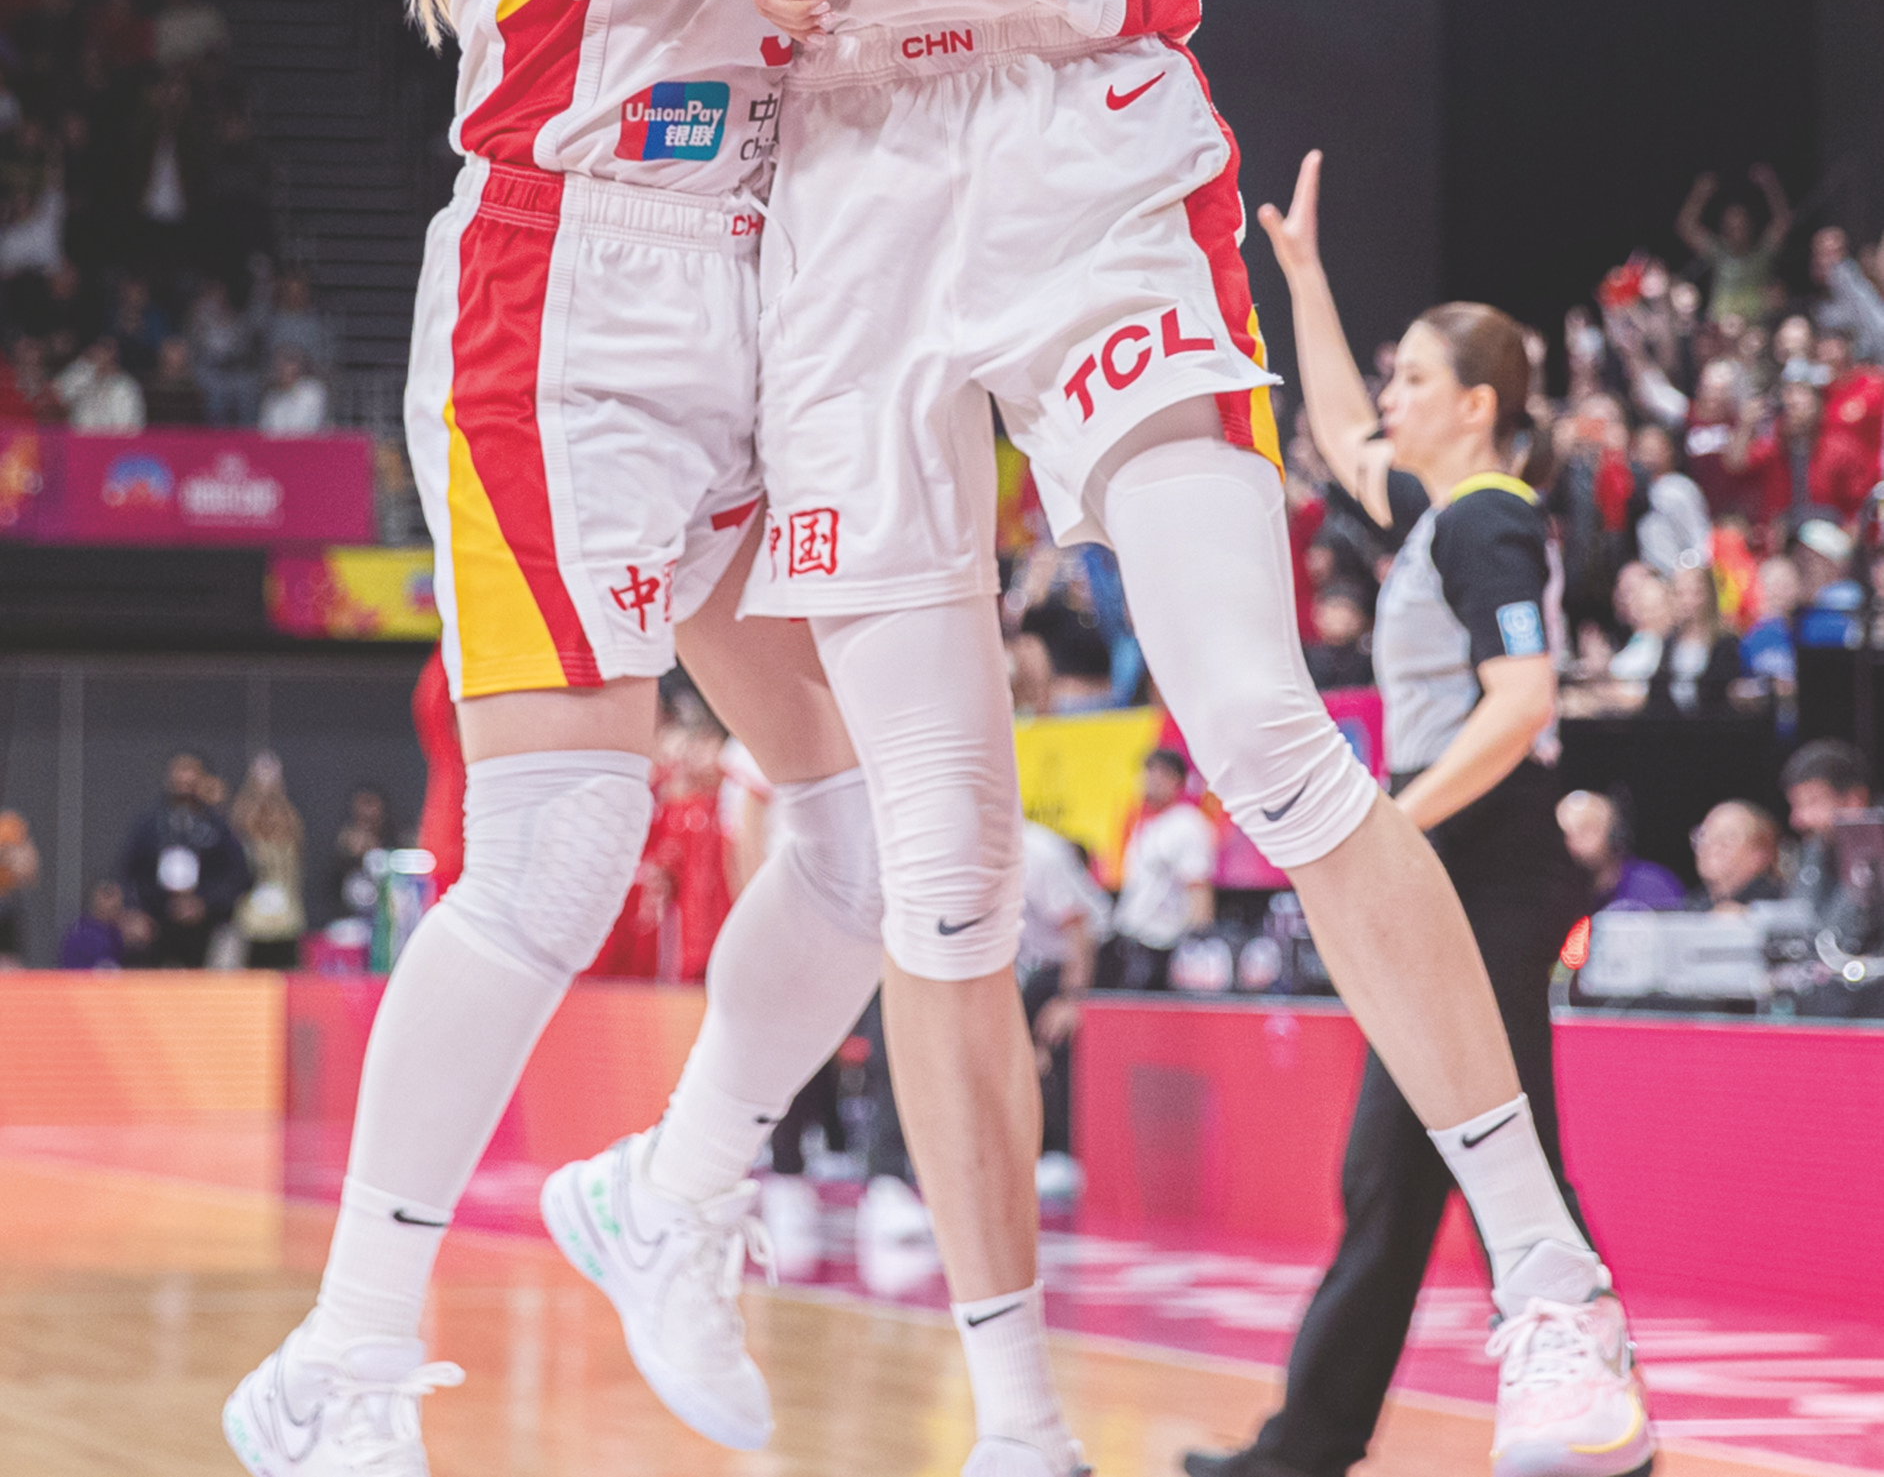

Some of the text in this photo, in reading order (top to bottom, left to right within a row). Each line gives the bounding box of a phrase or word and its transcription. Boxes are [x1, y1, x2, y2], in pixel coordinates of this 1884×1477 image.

[902, 28, 974, 59] CHN
[625, 100, 723, 130] UnionPay
[665, 124, 715, 146] 银联
[1063, 307, 1216, 425] TCL
